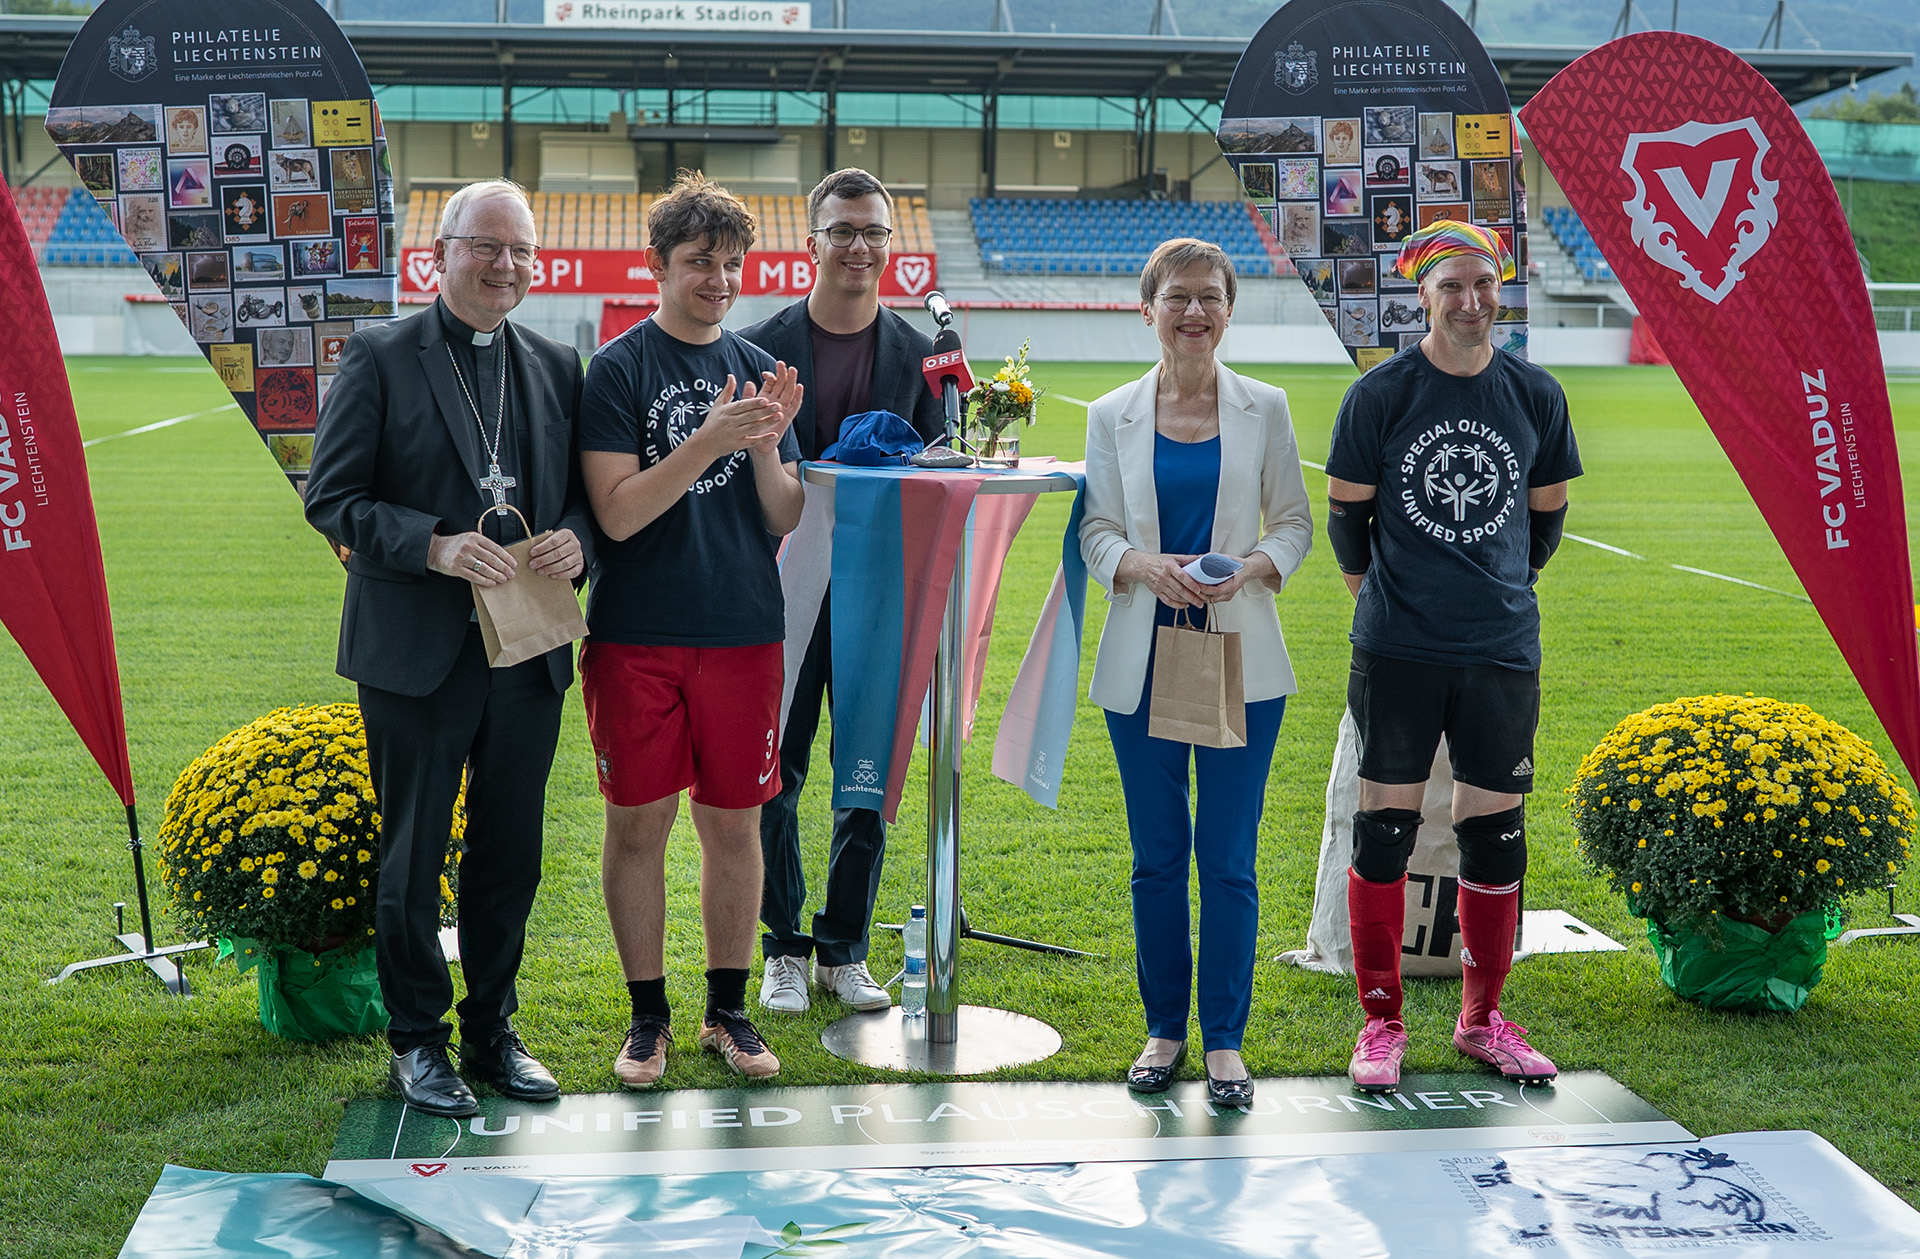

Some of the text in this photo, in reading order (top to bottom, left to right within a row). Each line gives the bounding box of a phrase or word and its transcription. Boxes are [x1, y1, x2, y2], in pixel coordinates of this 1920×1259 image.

[582, 4, 773, 22] Rheinpark Stadion
[172, 28, 281, 44] PHILATELIE
[173, 46, 321, 63] LIECHTENSTEIN
[1332, 45, 1431, 59] PHILATELIE
[175, 74, 190, 82] Eine
[191, 73, 214, 81] Marke
[228, 71, 294, 80] Liechtensteinischen
[1333, 62, 1466, 77] LIECHTENSTEIN
[1334, 87, 1347, 95] Eine
[1370, 86, 1381, 94] der
[1382, 85, 1441, 94] Liechtensteinischen
[1442, 85, 1456, 93] Post
[530, 258, 583, 288] BPI
[759, 260, 812, 289] MB
[925, 352, 961, 368] ORF
[14, 391, 49, 507] LIECHTENSTEIN
[1401, 419, 1520, 481] SPECIAL OLYMPICS
[1800, 368, 1850, 550] FC VADUZ
[1840, 402, 1866, 509] LIECHTENSTEIN
[696, 450, 747, 494] SPORTS
[0, 499, 32, 552] FC
[1401, 489, 1515, 544] UNIFIED SPORTS
[765, 728, 774, 760] 3
[1512, 768, 1535, 777] adida
[469, 1090, 1519, 1137] UNIFIED PLAUSCHTURNIER
[1517, 1221, 1799, 1240] LCHTENSTEIN
